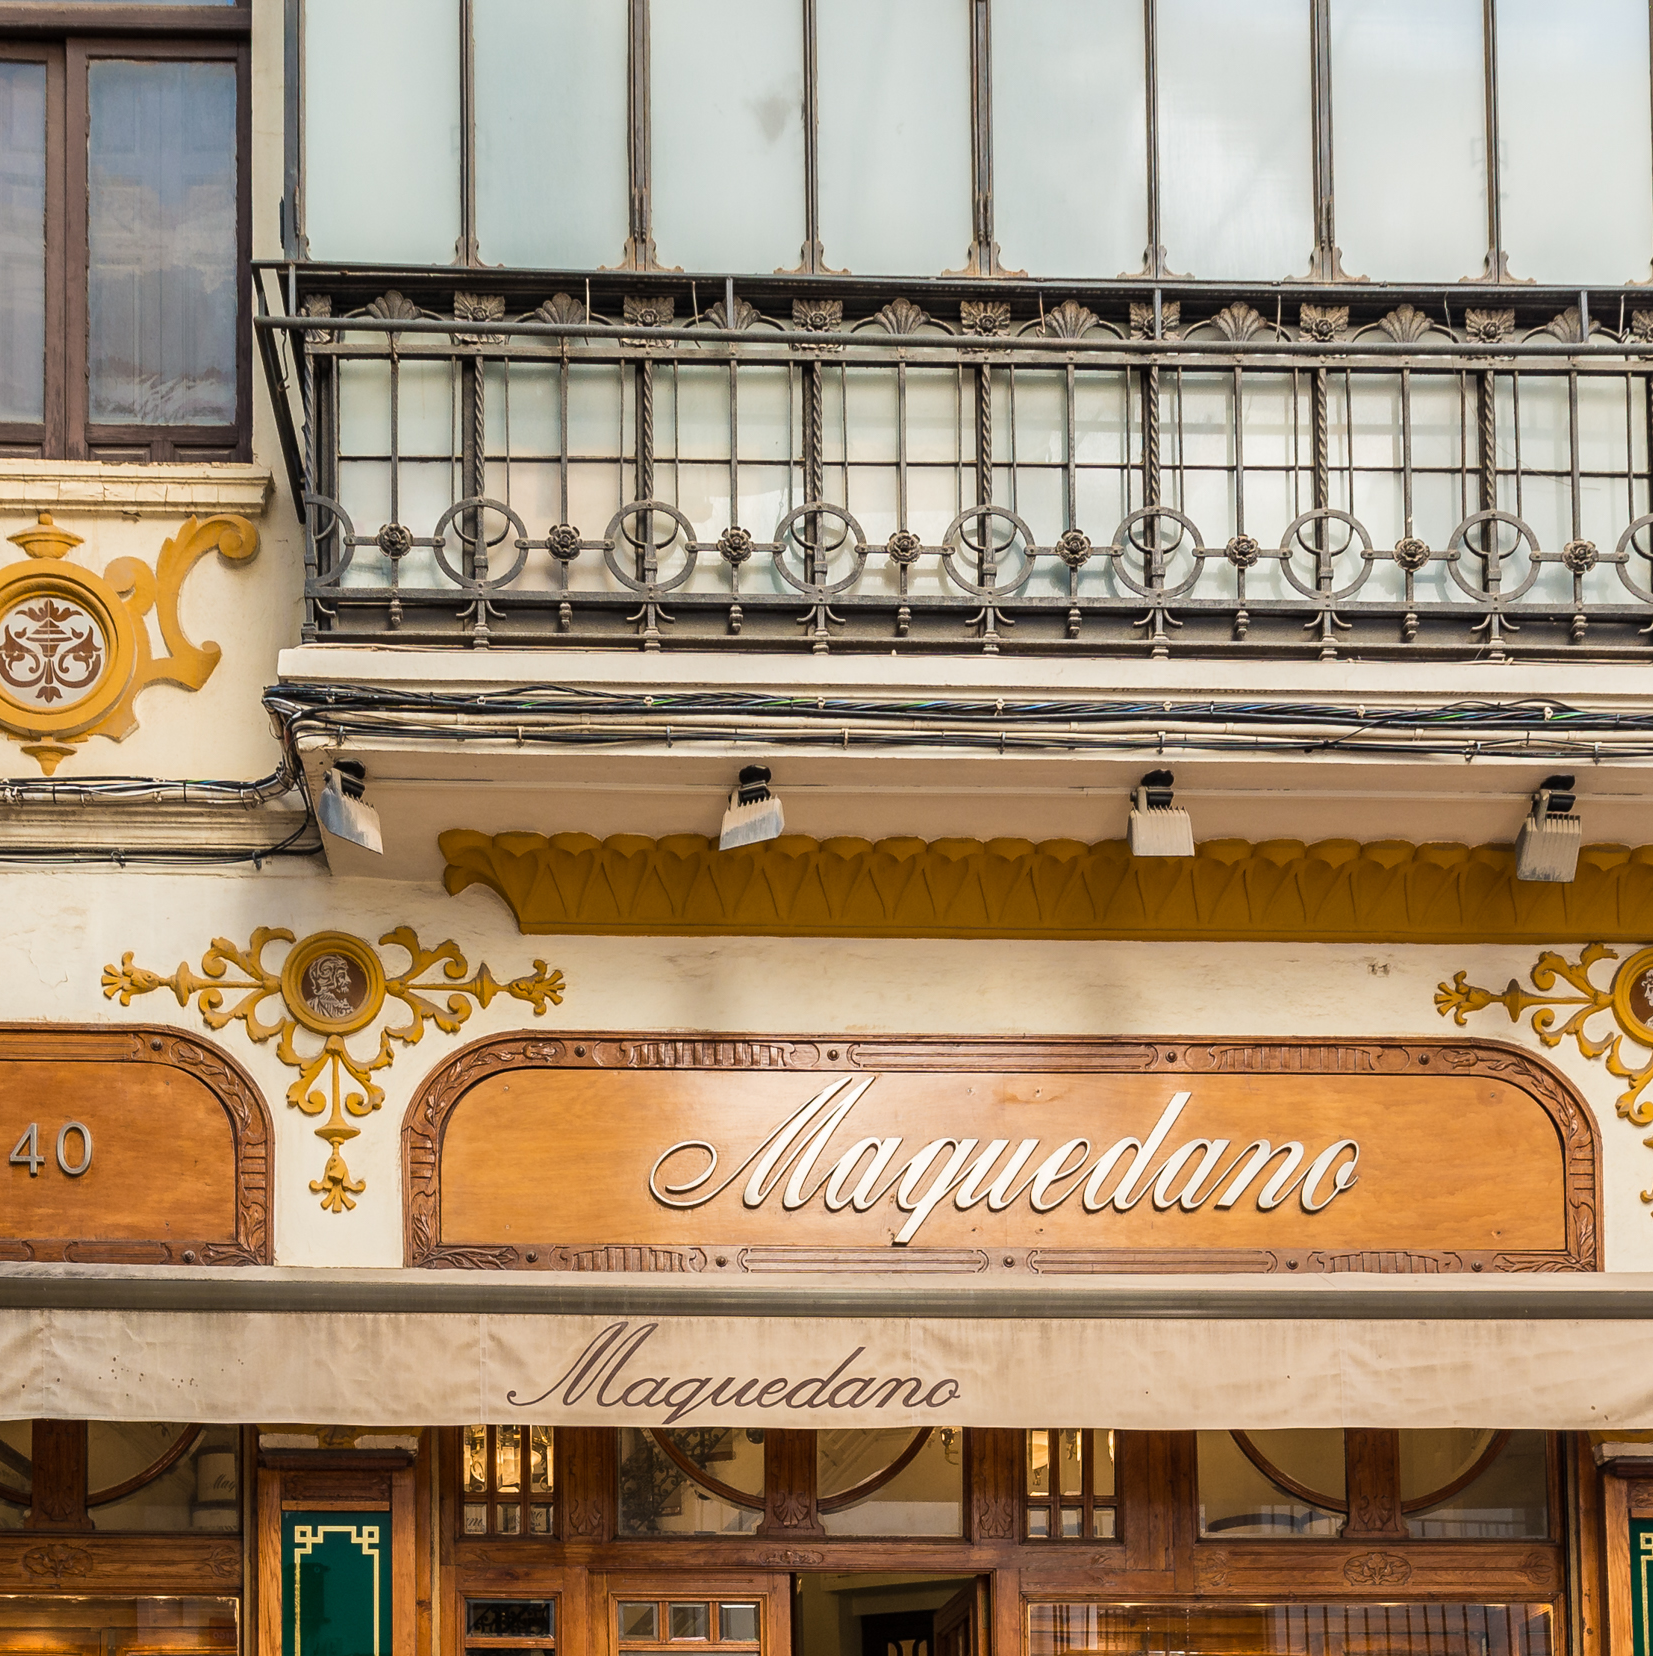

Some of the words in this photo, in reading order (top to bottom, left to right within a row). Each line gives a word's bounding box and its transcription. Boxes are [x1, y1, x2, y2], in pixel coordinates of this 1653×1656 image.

[9, 1121, 93, 1176] 40
[649, 1076, 1360, 1246] Maquedano
[507, 1321, 961, 1425] Maquedano
